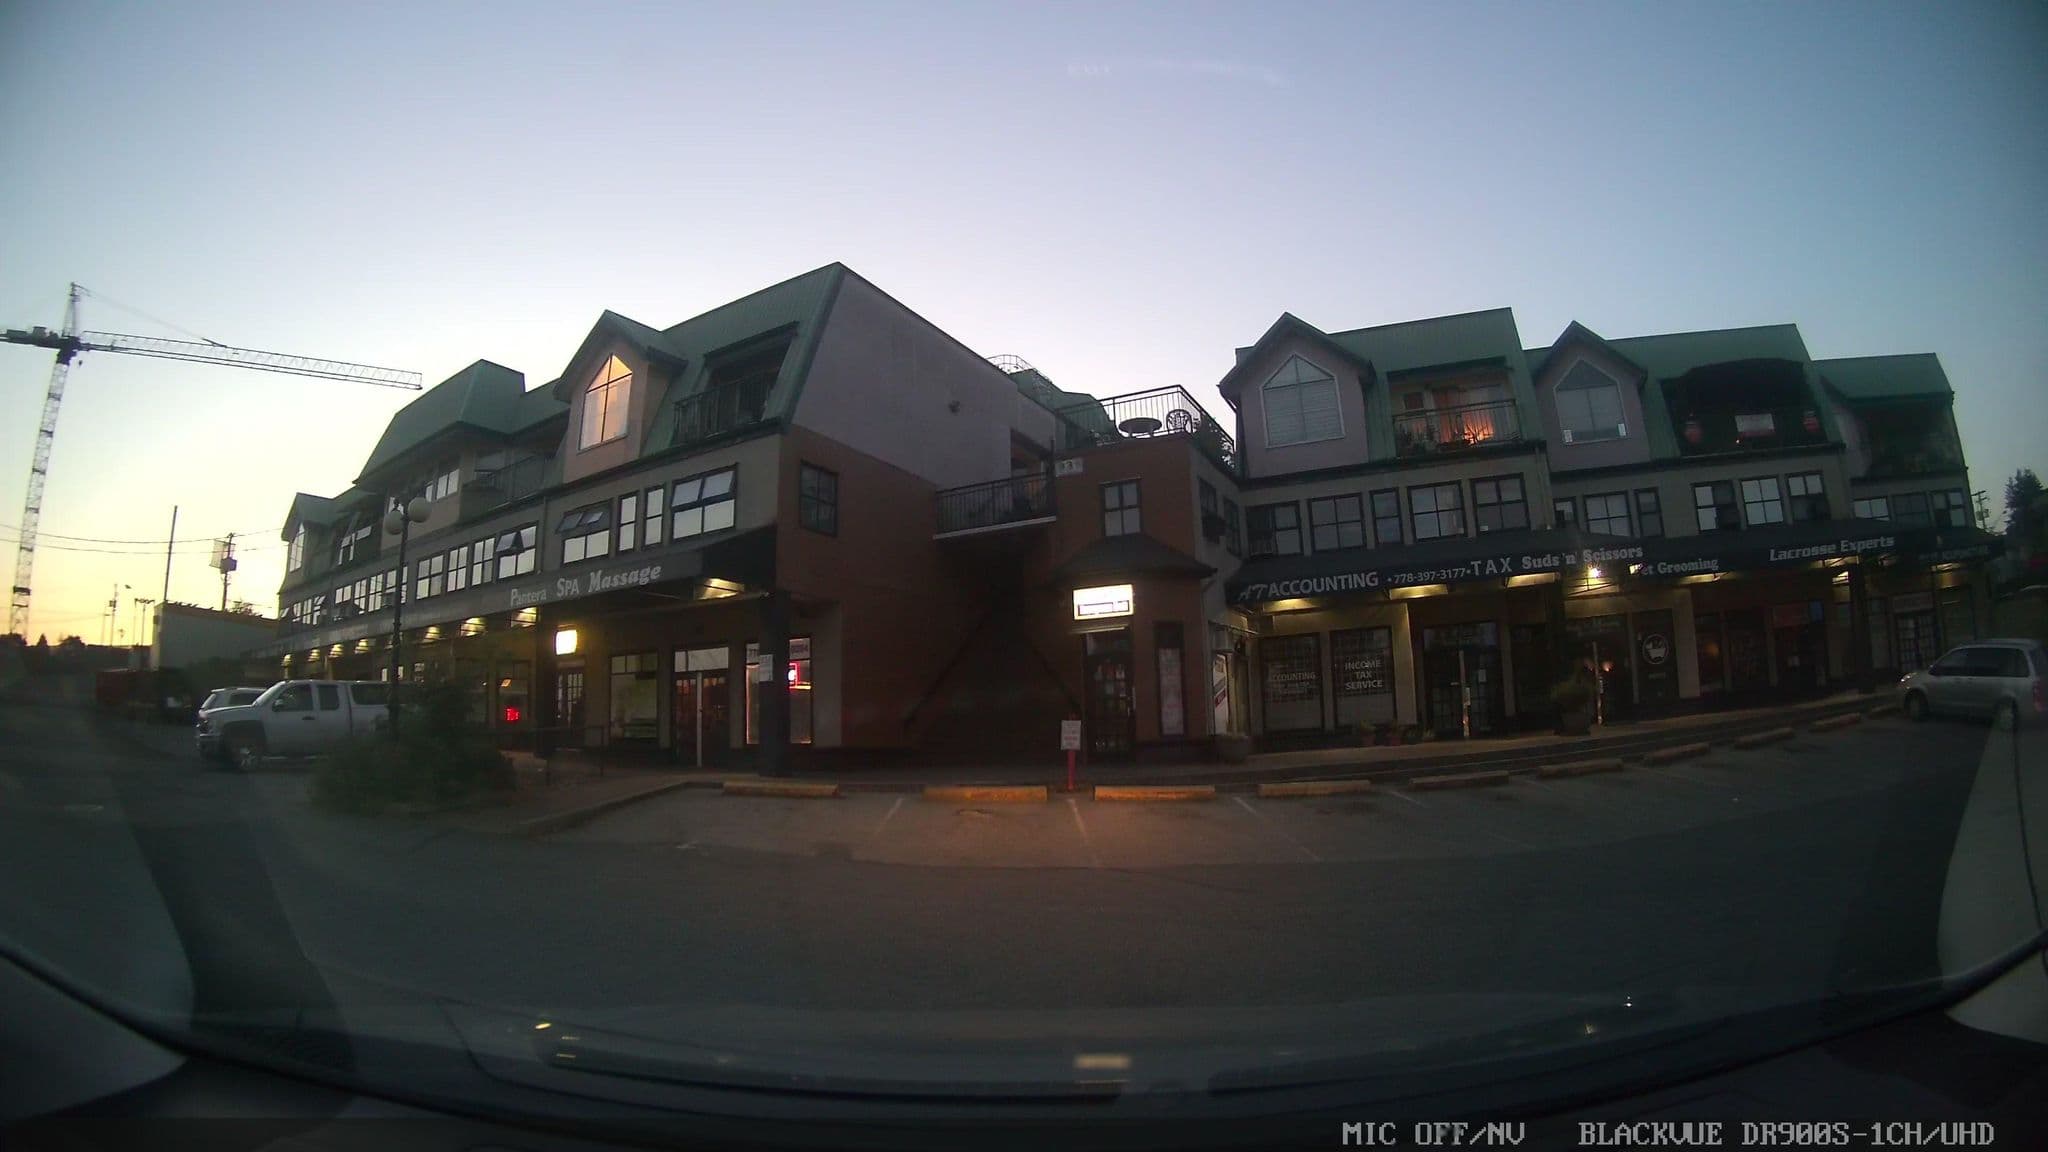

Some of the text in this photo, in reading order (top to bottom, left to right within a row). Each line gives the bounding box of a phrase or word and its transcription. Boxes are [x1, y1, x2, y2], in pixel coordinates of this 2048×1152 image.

[1521, 555, 1560, 570] Suds
[1582, 546, 1643, 563] Scissors
[1770, 535, 1895, 562] Lacrosse Experts
[1657, 558, 1719, 575] Grooming
[556, 577, 580, 598] SPA
[588, 565, 662, 593] Massage
[1268, 571, 1379, 598] ACCOUNTING
[1470, 557, 1513, 576] TAX
[1345, 659, 1381, 671] INCOME
[1355, 670, 1372, 679] TAX
[1345, 679, 1383, 690] SERVICE
